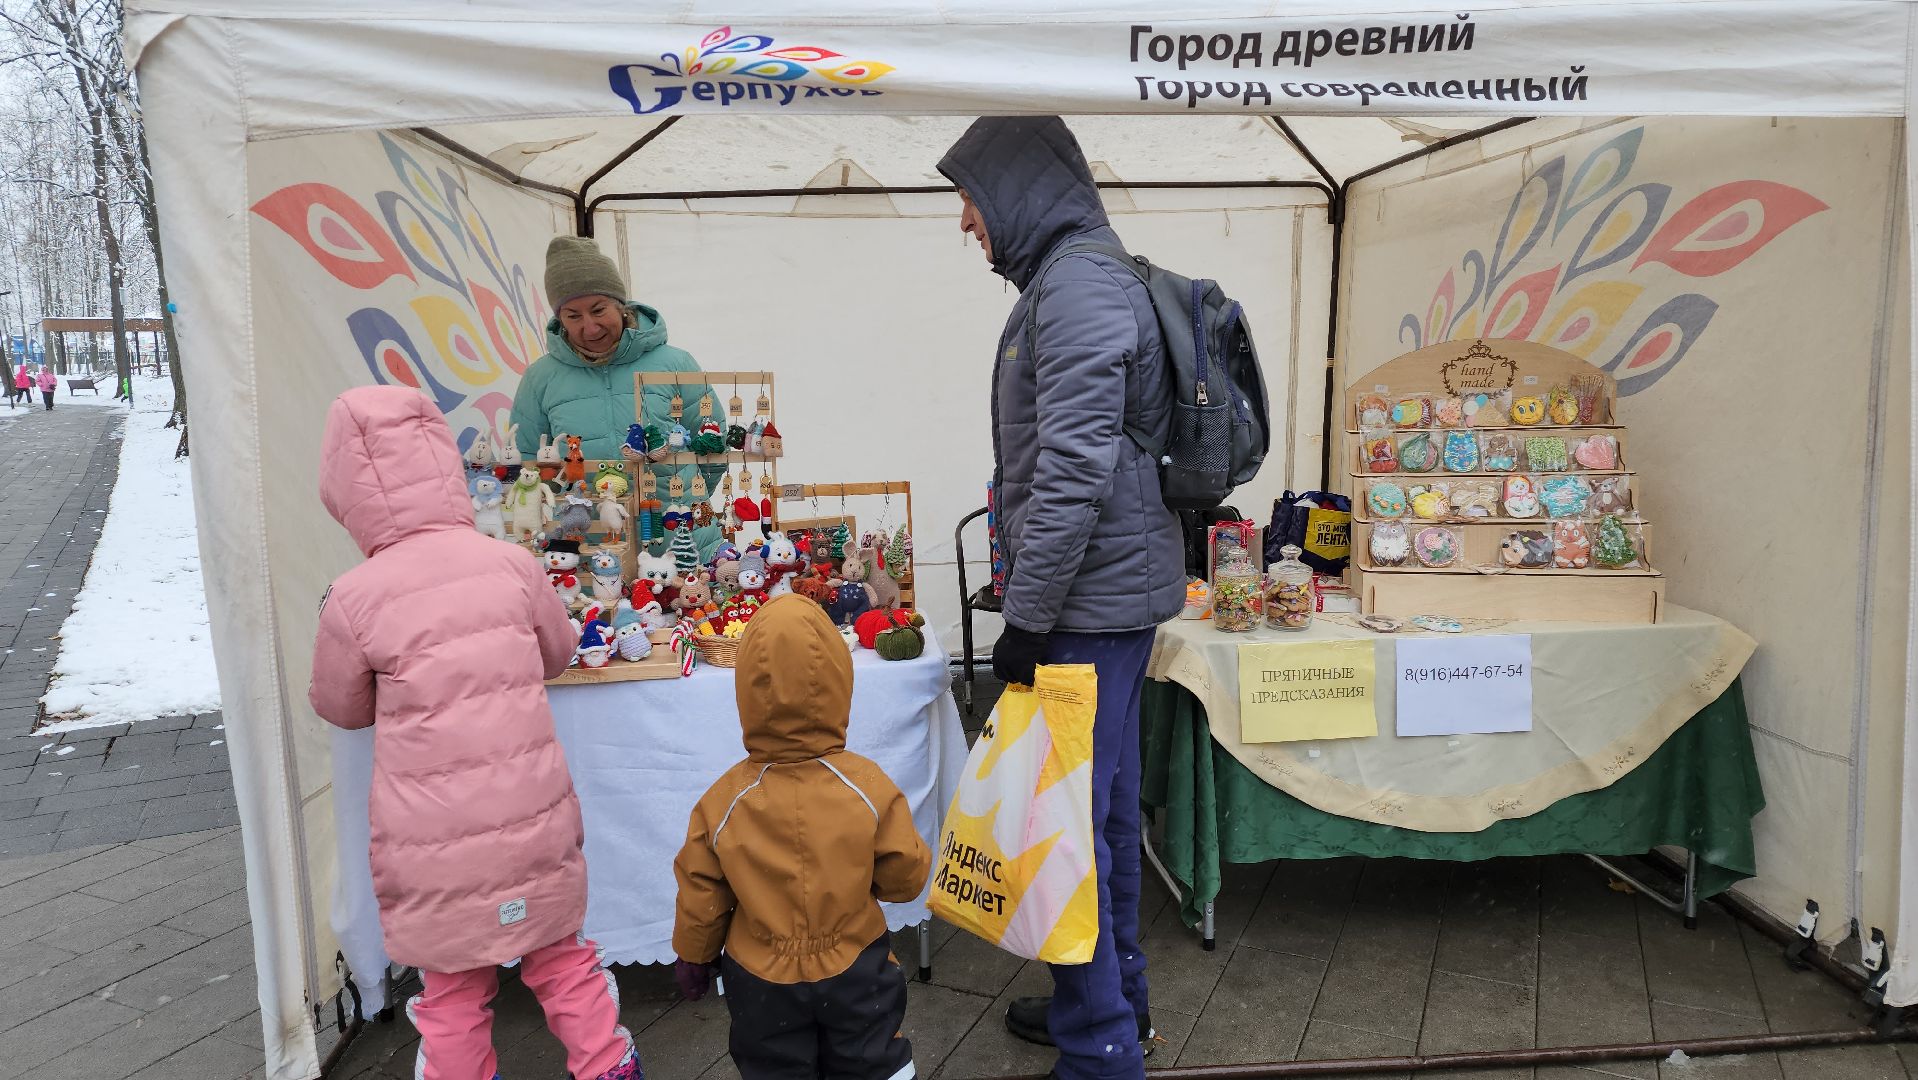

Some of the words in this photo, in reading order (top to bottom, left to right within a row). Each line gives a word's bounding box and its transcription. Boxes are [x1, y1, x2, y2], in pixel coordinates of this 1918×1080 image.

[1130, 25, 1262, 70] Город
[1272, 13, 1475, 67] древний
[1135, 76, 1271, 108] Город
[1280, 65, 1589, 107] современный
[1461, 363, 1496, 376] hand
[1461, 375, 1495, 388] made
[1317, 523, 1331, 533] ЭТО
[1315, 533, 1347, 546] ЛЕНТА
[1261, 667, 1355, 682] ПРЯНИЧНЫЕ
[1404, 663, 1523, 684] 8(916)447-67-54
[1251, 686, 1365, 704] ПРЕДСКАЗАНИЯ
